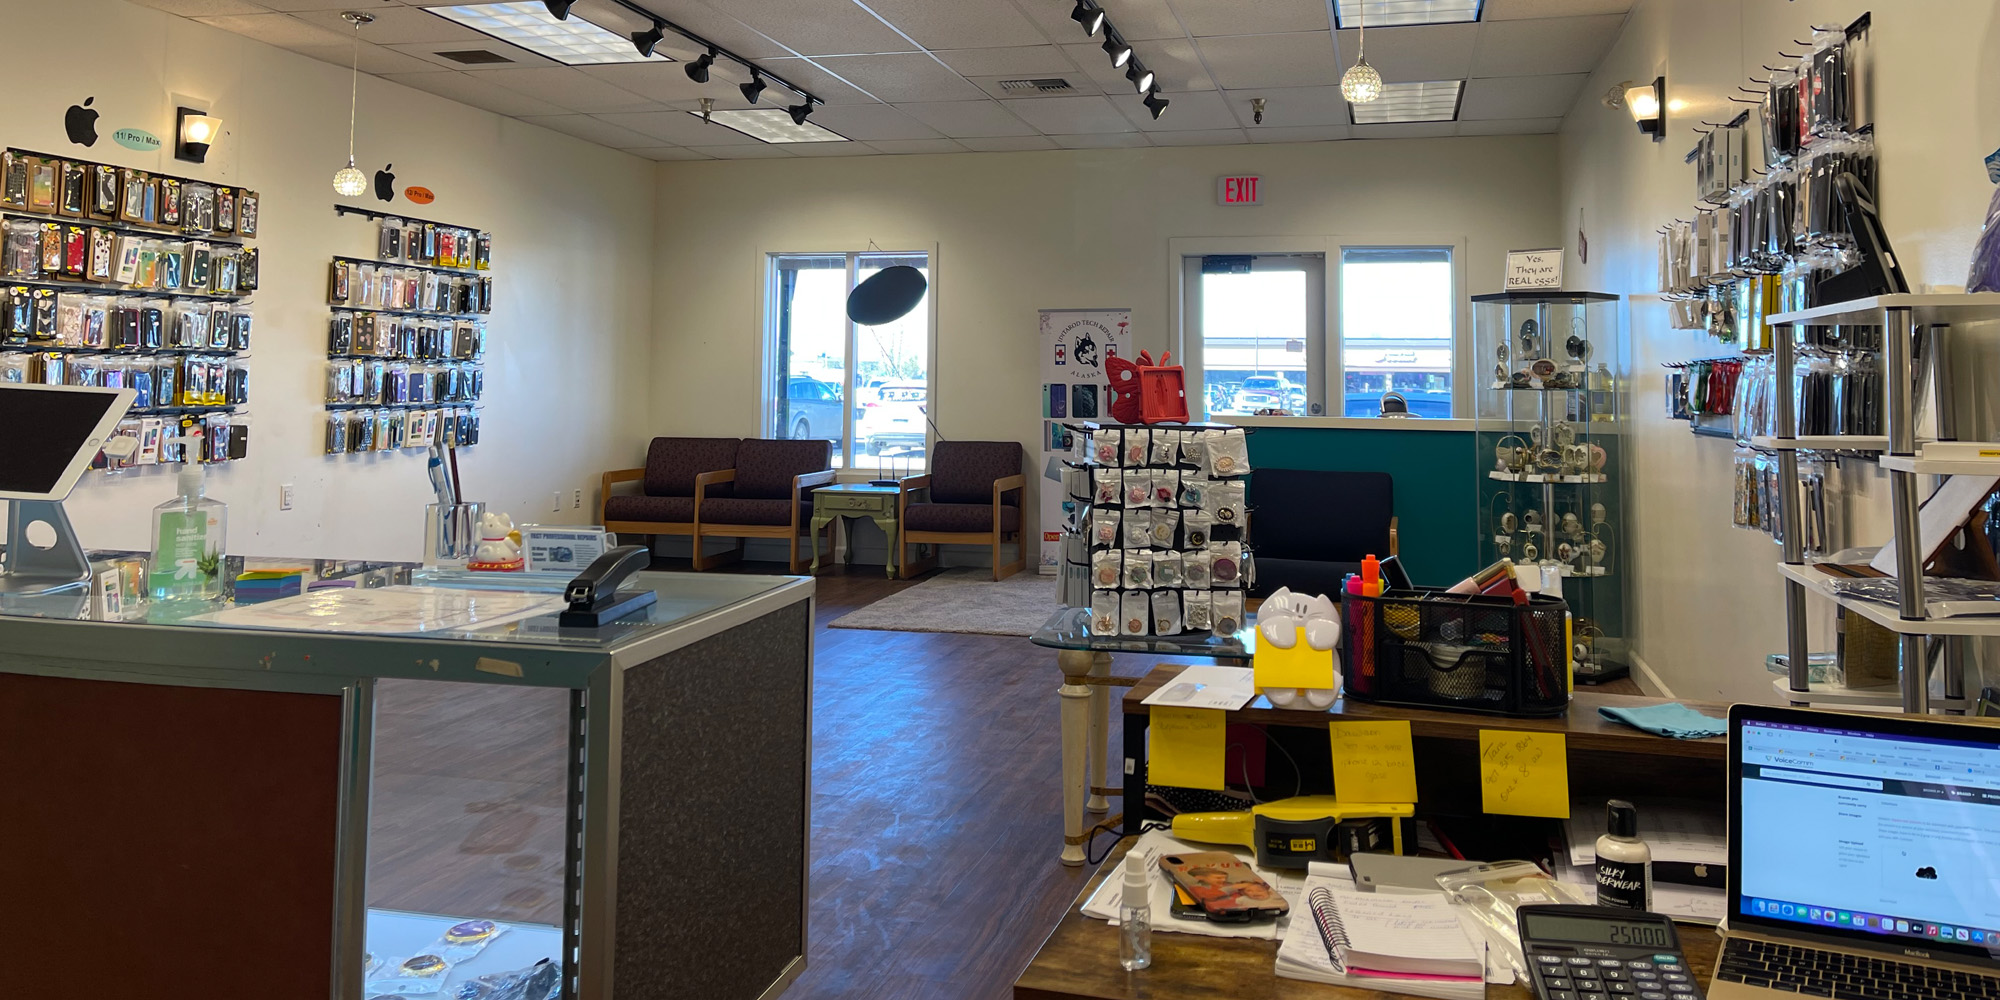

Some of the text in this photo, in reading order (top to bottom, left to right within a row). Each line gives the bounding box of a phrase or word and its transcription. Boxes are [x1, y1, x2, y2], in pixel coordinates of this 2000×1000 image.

[127, 132, 140, 142] Pro
[146, 136, 160, 146] Max
[1225, 177, 1259, 203] EXIT
[1516, 265, 1537, 275] They
[1508, 275, 1558, 286] REAL eggs!
[1057, 319, 1115, 343] IDITAROD TECH REPAIR
[1070, 370, 1102, 379] ALASKA
[176, 526, 198, 535] hand
[1774, 756, 1814, 766] VoiceComm
[1600, 865, 1625, 879] SILKY
[1610, 925, 1666, 946] 25000
[1904, 948, 1930, 958] MacBook
